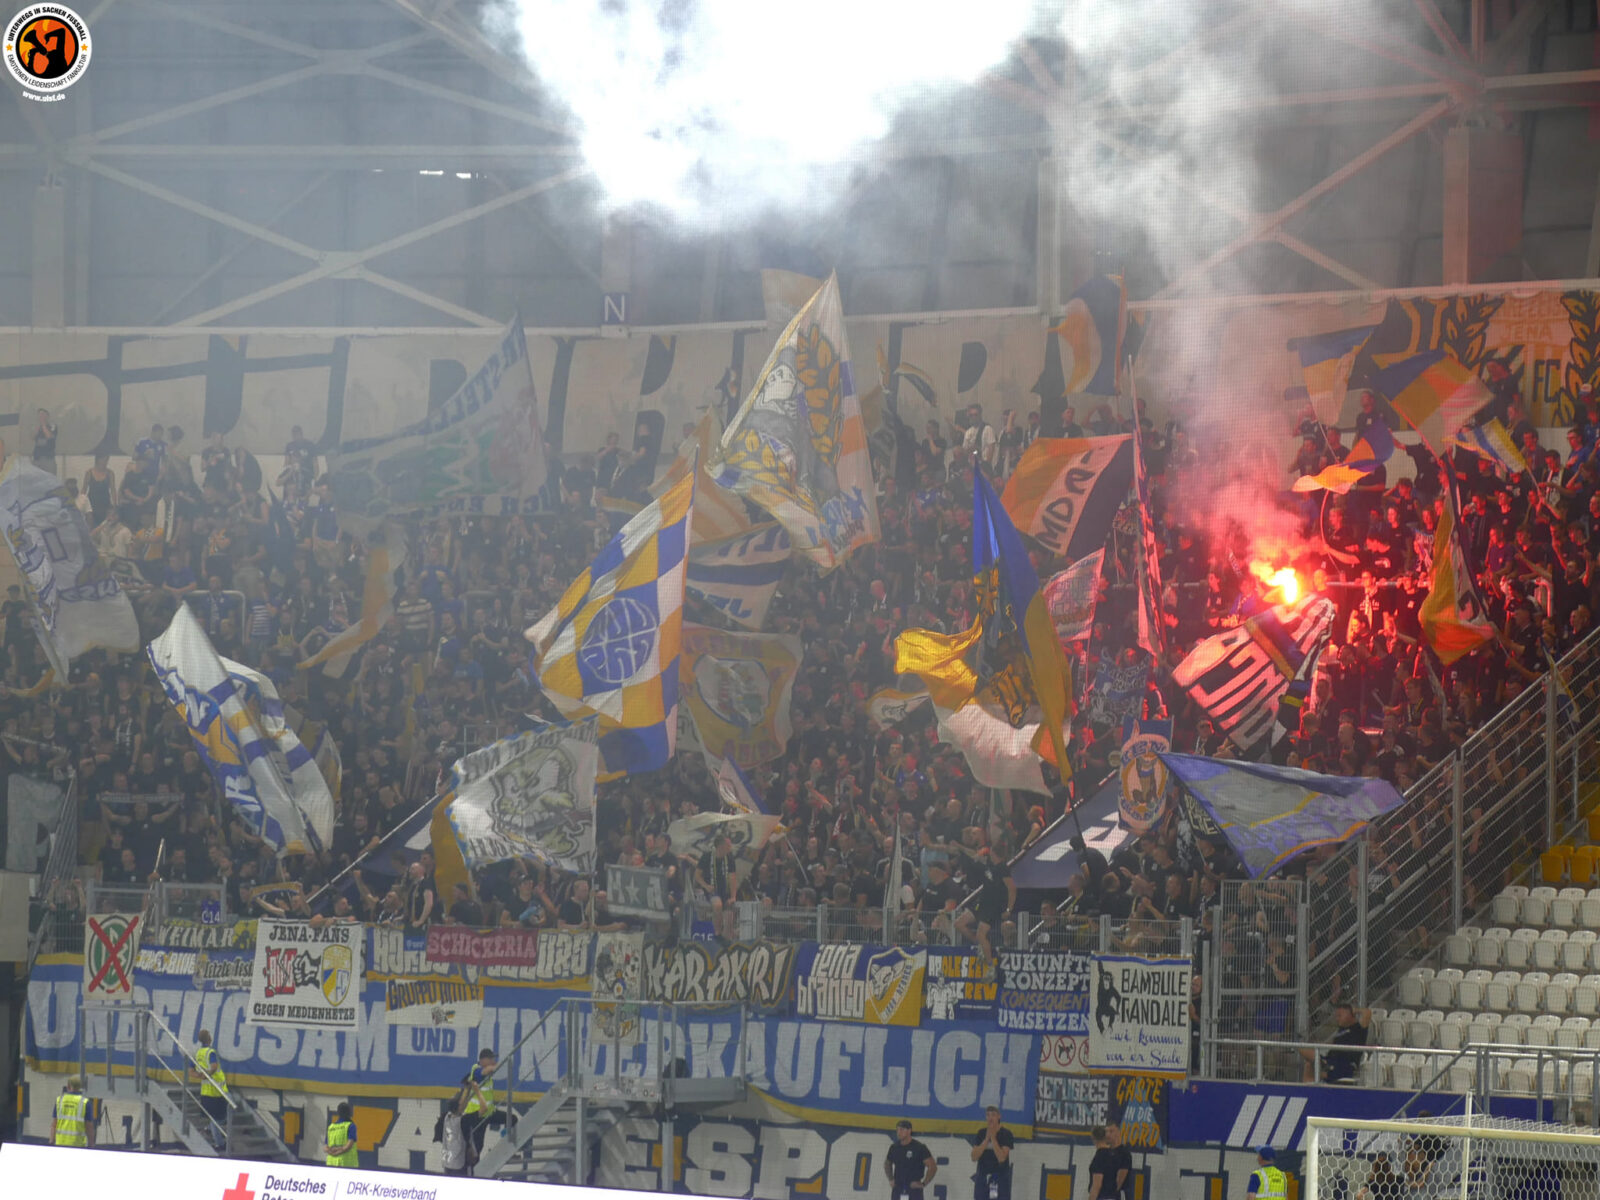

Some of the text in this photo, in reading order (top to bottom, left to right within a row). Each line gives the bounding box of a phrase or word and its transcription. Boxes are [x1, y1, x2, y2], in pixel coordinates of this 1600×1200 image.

[604, 294, 625, 322] N
[159, 925, 235, 948] WEIMAR
[426, 932, 538, 961] SCHICKERIA
[1120, 967, 1188, 997] BAMBULE
[253, 1003, 286, 1018] GEGEN
[287, 1005, 356, 1021] MEDIENHETZE
[1120, 997, 1187, 1028] RANDALE
[411, 1027, 457, 1053] UND
[1037, 1075, 1110, 1102] REFUGEES
[1036, 1100, 1109, 1127] WELCOME
[265, 1175, 327, 1194] Deutsches
[347, 1181, 438, 1200] DRK-Kreisverband
